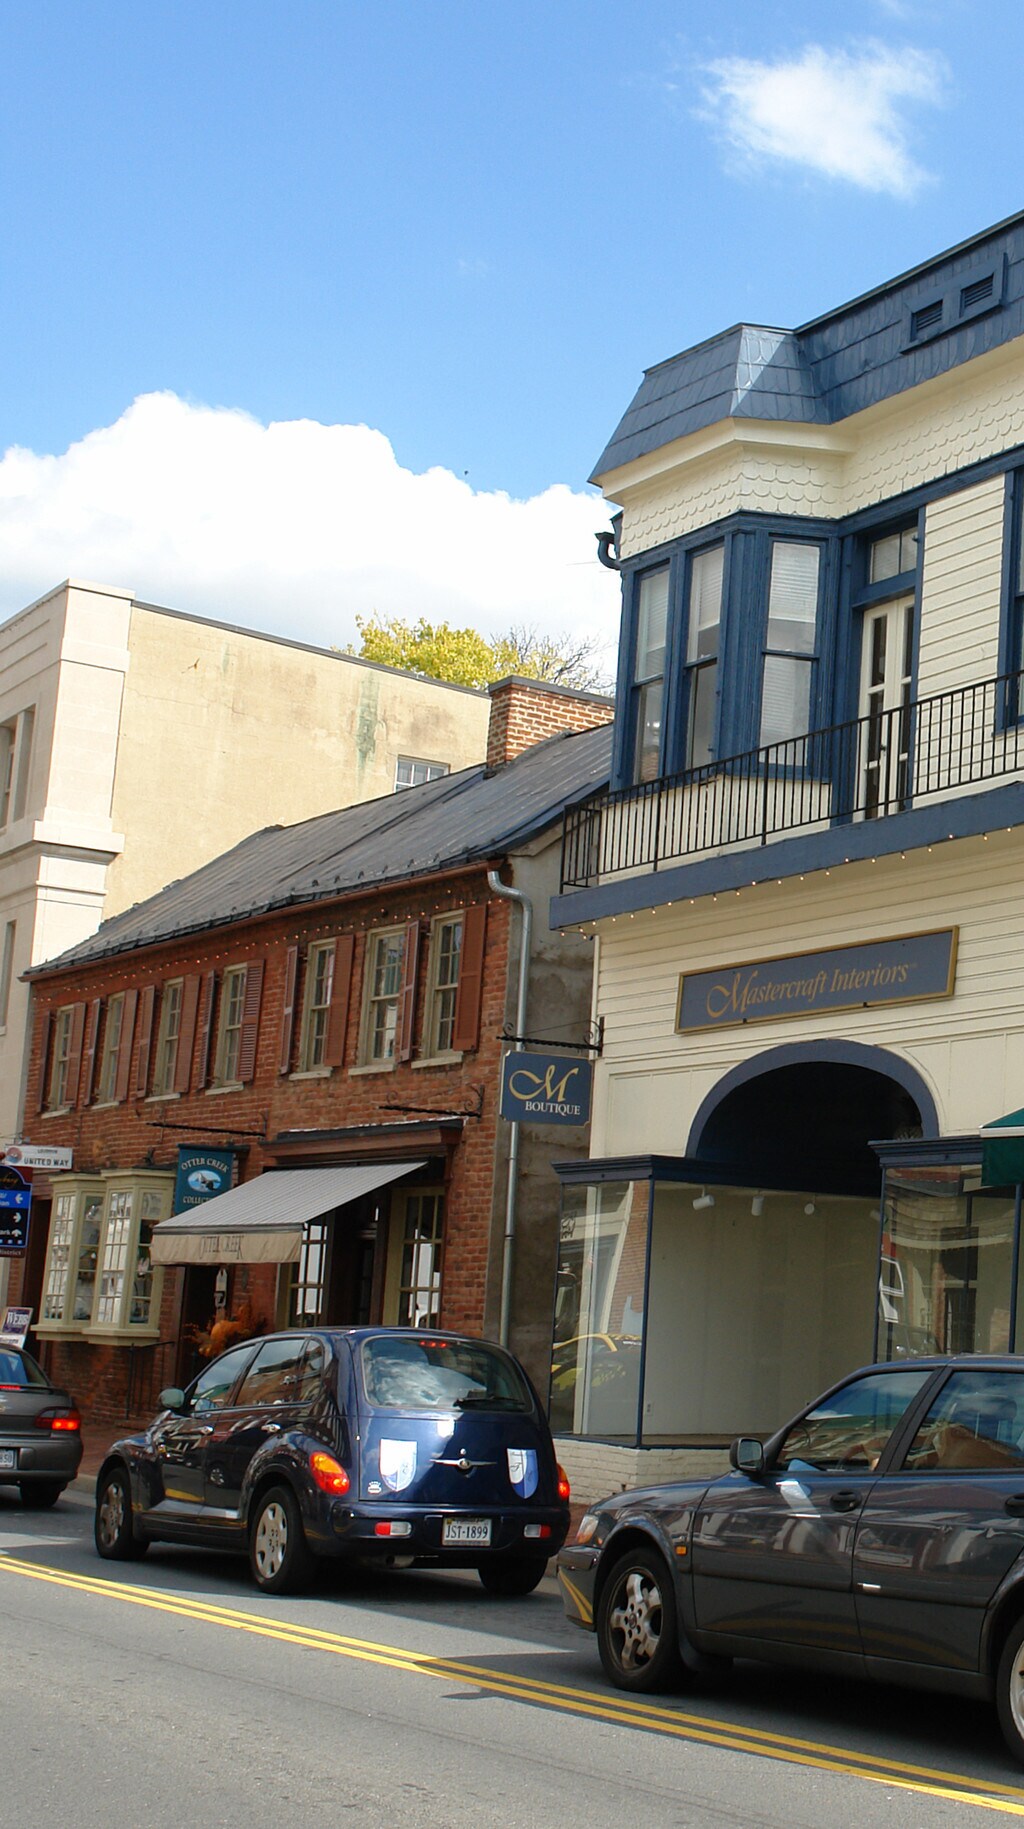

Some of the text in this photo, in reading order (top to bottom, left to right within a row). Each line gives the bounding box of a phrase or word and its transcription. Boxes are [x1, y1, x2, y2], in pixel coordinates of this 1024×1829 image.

[706, 963, 909, 1018] Mastercraft Interiors
[508, 1064, 580, 1103] M
[524, 1100, 581, 1117] BOUTIQUE
[24, 1157, 70, 1167] UNITED WAY
[181, 1157, 230, 1173] OTTER CREEK
[182, 1195, 213, 1205] COLLECT
[445, 1524, 489, 1540] JST-1899
